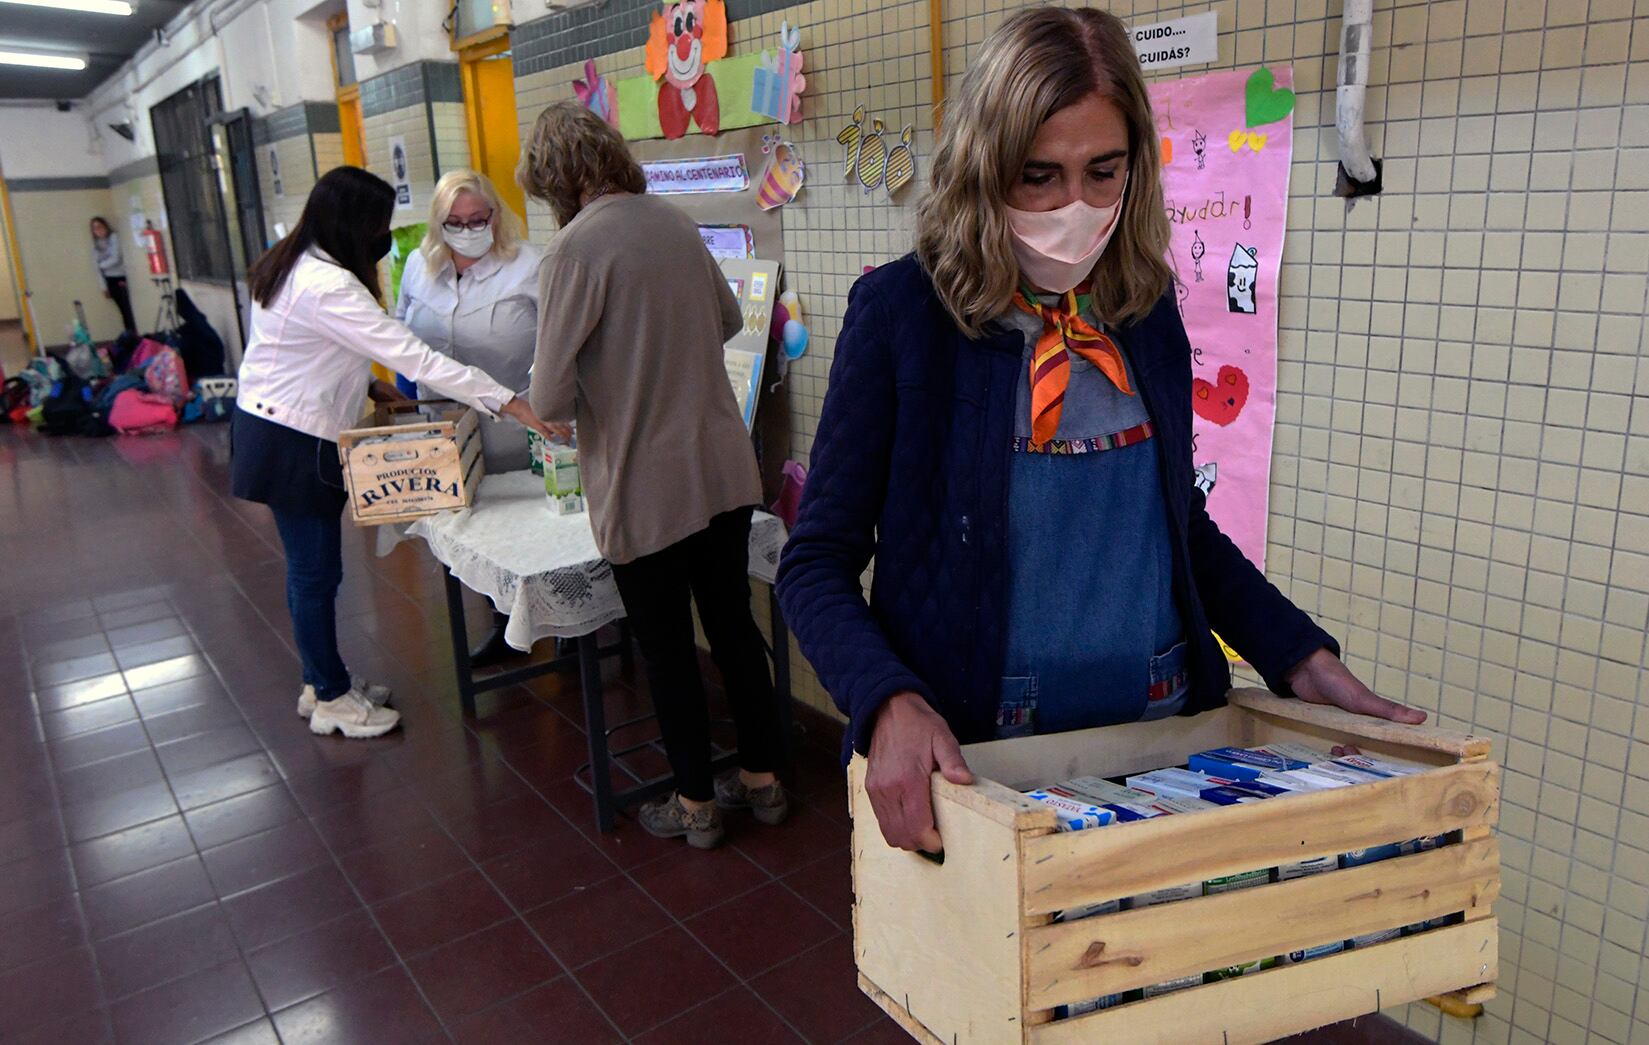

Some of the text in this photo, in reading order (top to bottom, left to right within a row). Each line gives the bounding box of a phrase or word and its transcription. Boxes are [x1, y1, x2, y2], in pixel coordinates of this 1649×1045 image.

[1135, 26, 1186, 42] CUIDO....
[1139, 46, 1191, 64] CUIDÁS?
[686, 164, 743, 181] CENTENARIO
[376, 468, 437, 481] PRODUCTOS
[361, 476, 460, 506] RIVERA
